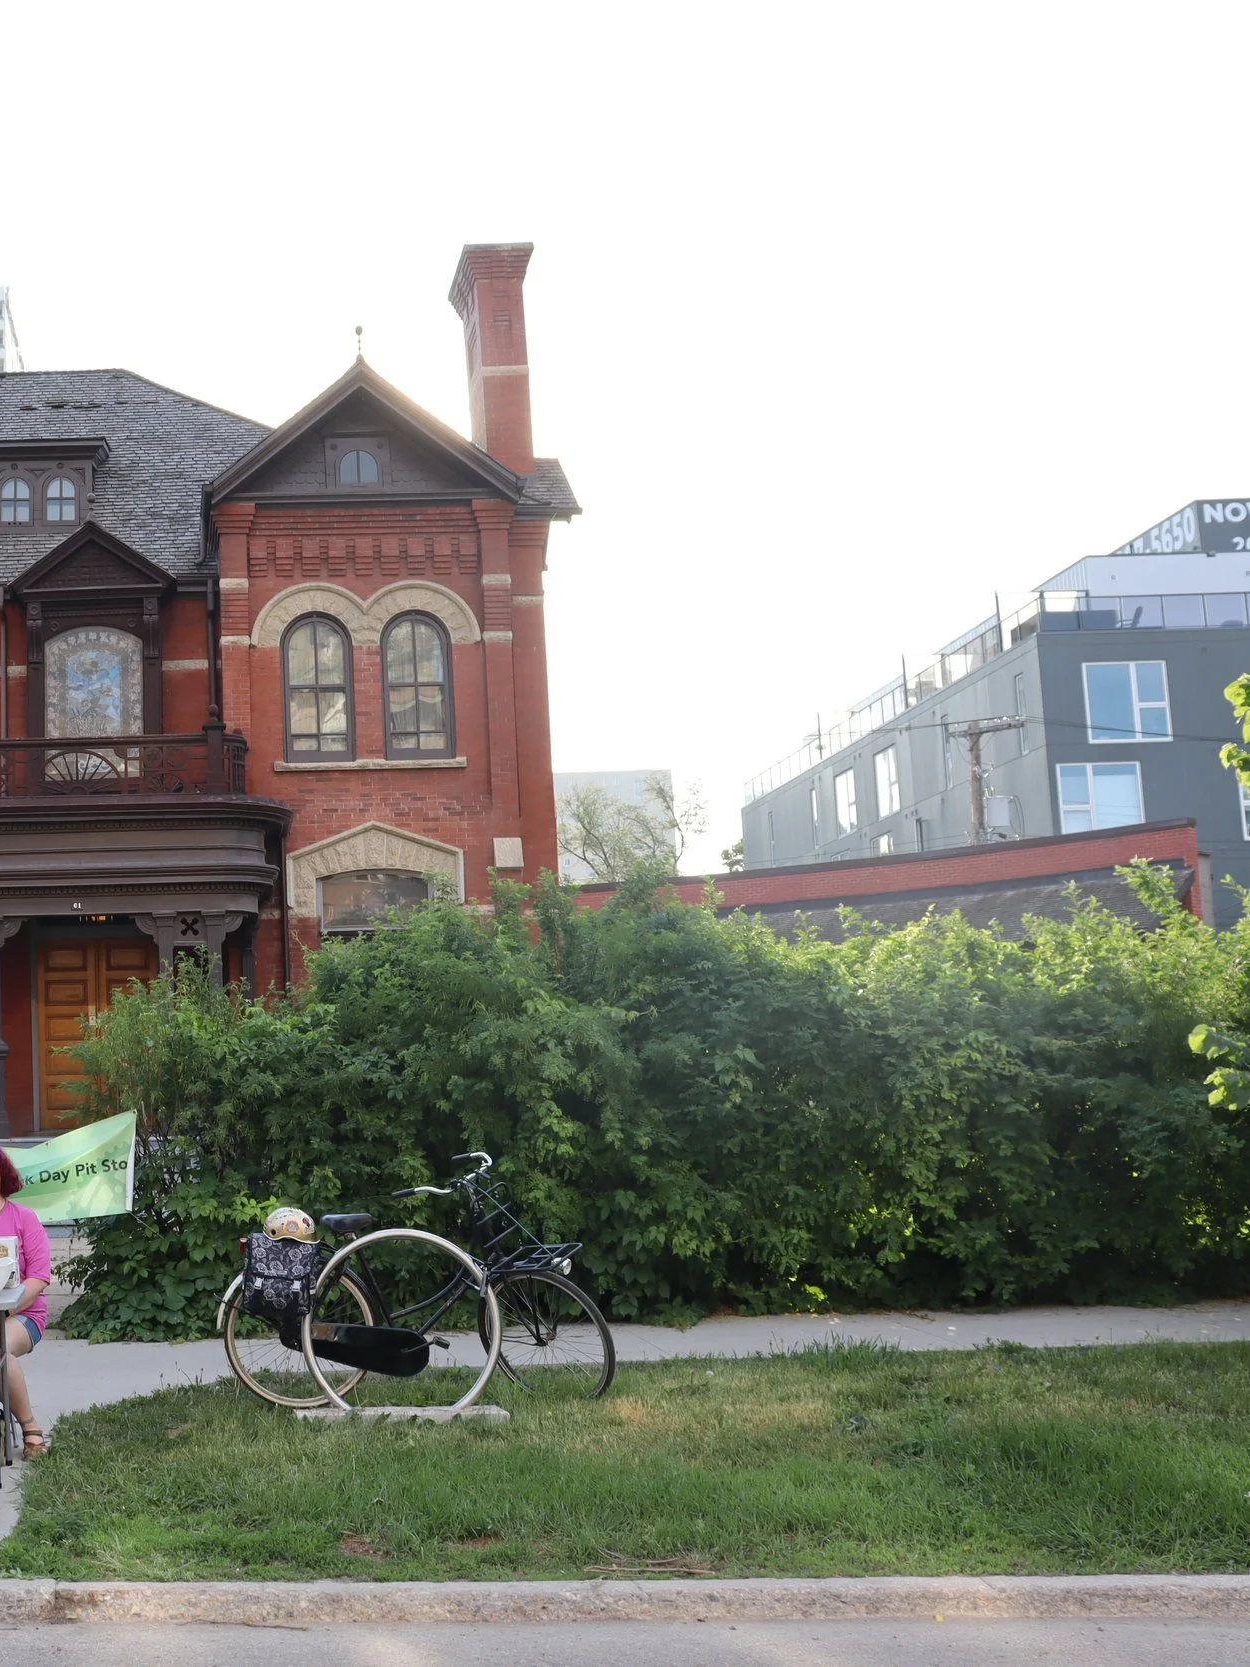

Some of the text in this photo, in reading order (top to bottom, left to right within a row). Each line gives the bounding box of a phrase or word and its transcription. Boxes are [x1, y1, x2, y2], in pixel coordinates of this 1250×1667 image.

[39, 1169, 70, 1183] Day
[75, 1162, 97, 1177] Pit
[101, 1159, 128, 1172] Sto
